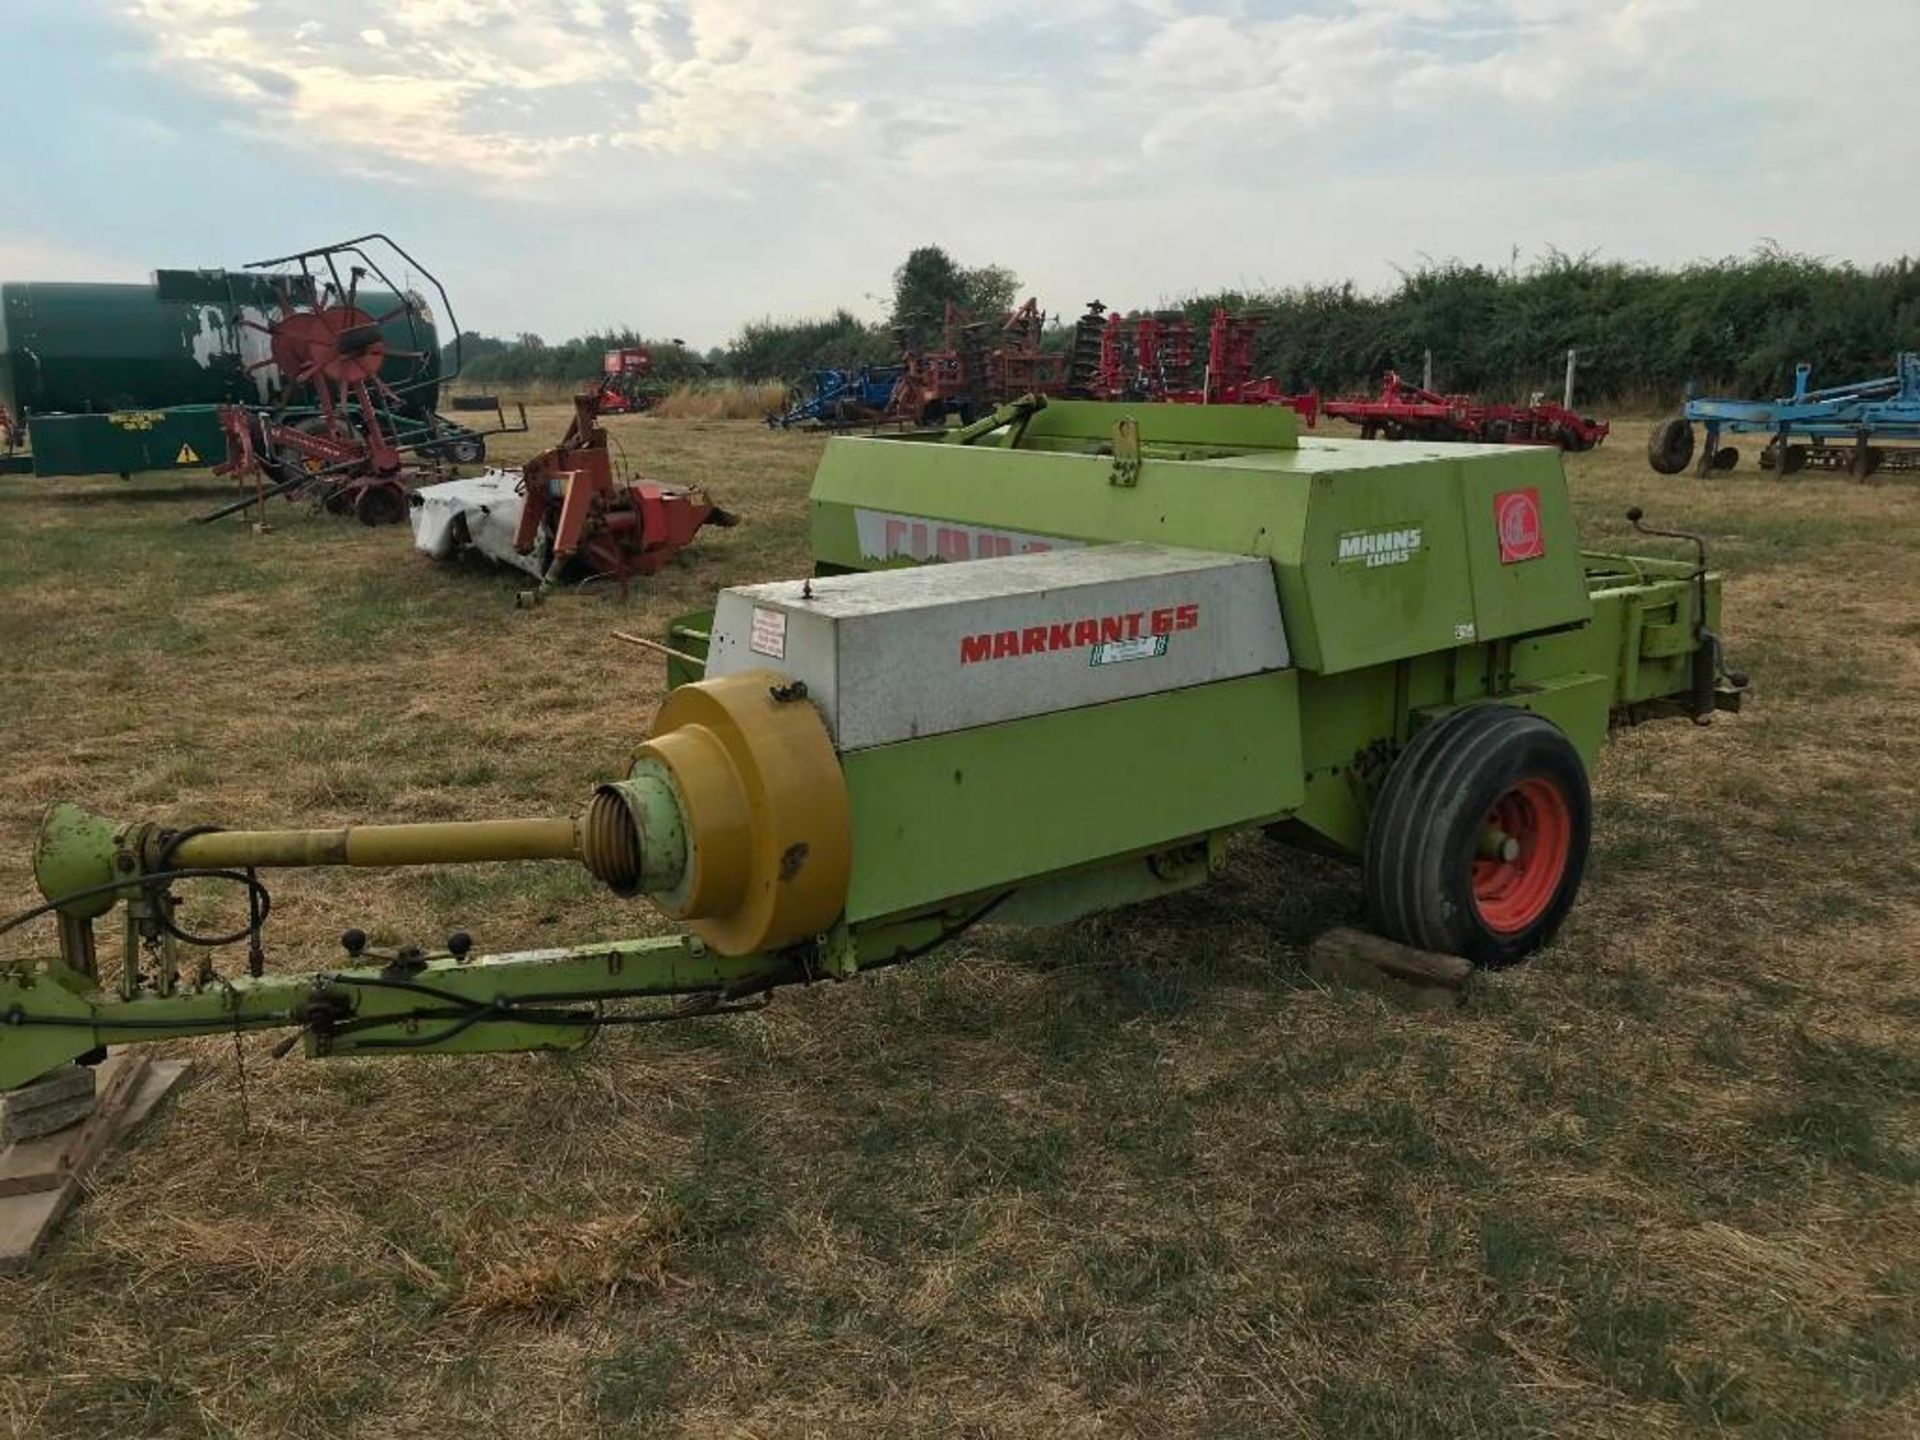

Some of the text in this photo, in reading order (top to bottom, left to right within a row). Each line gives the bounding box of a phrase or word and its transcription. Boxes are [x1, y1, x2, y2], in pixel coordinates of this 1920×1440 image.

[1339, 529, 1421, 557] MANNS
[960, 612, 1143, 667] MARKANT
[1151, 603, 1199, 635] 65
